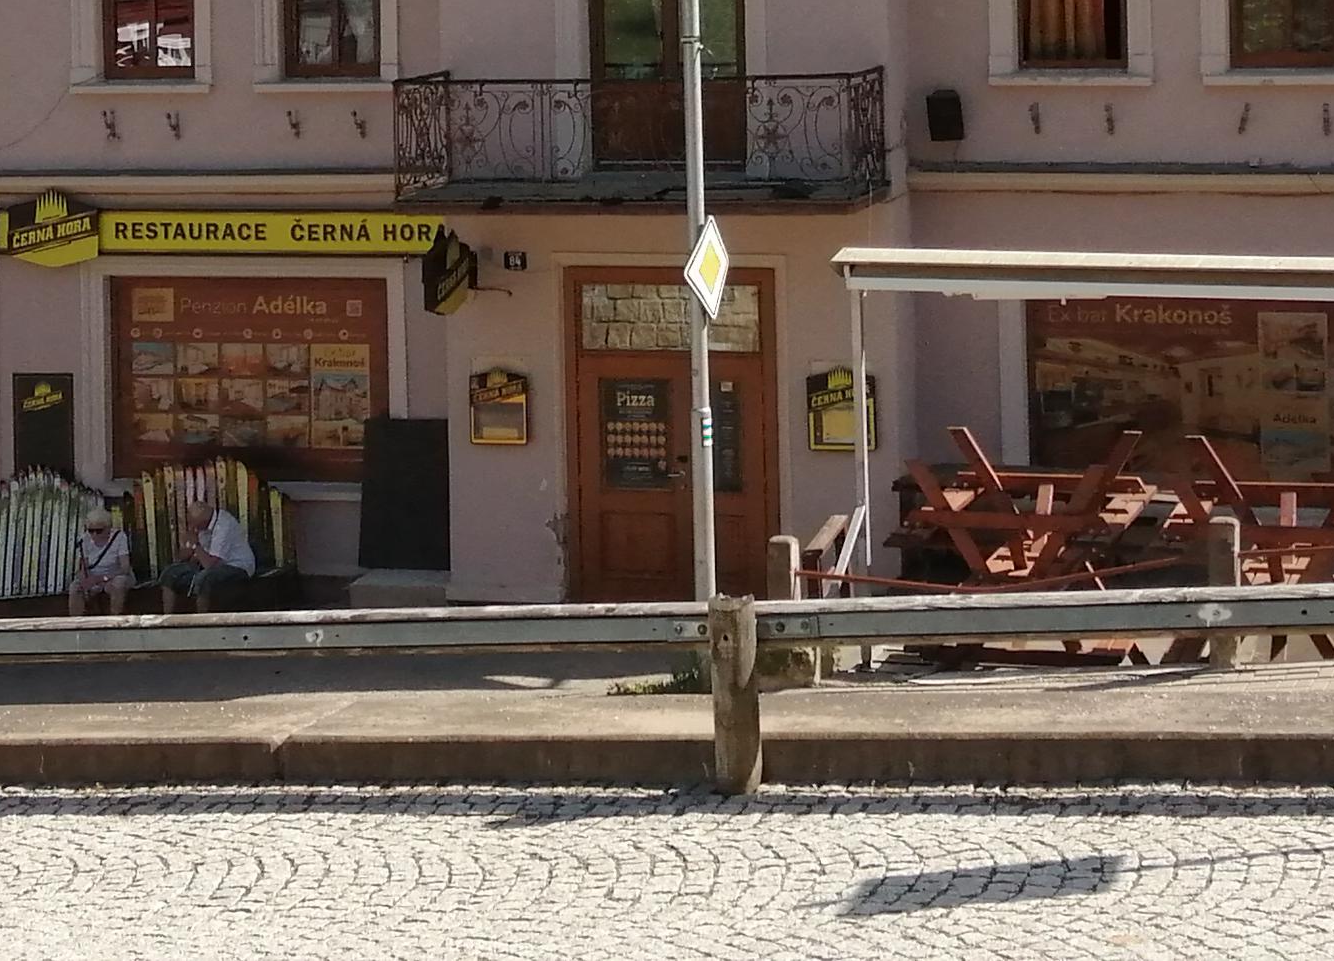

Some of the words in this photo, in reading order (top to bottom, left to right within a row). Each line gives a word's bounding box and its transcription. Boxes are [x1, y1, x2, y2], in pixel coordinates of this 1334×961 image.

[57, 217, 91, 238] HORA
[114, 222, 267, 241] RESTAURACE
[290, 218, 371, 242] ČERNÁ
[509, 255, 521, 266] 84
[180, 297, 247, 314] Penzion
[252, 295, 328, 315] Adélka
[1116, 303, 1233, 325] Krakonoš
[616, 390, 655, 407] Pizza
